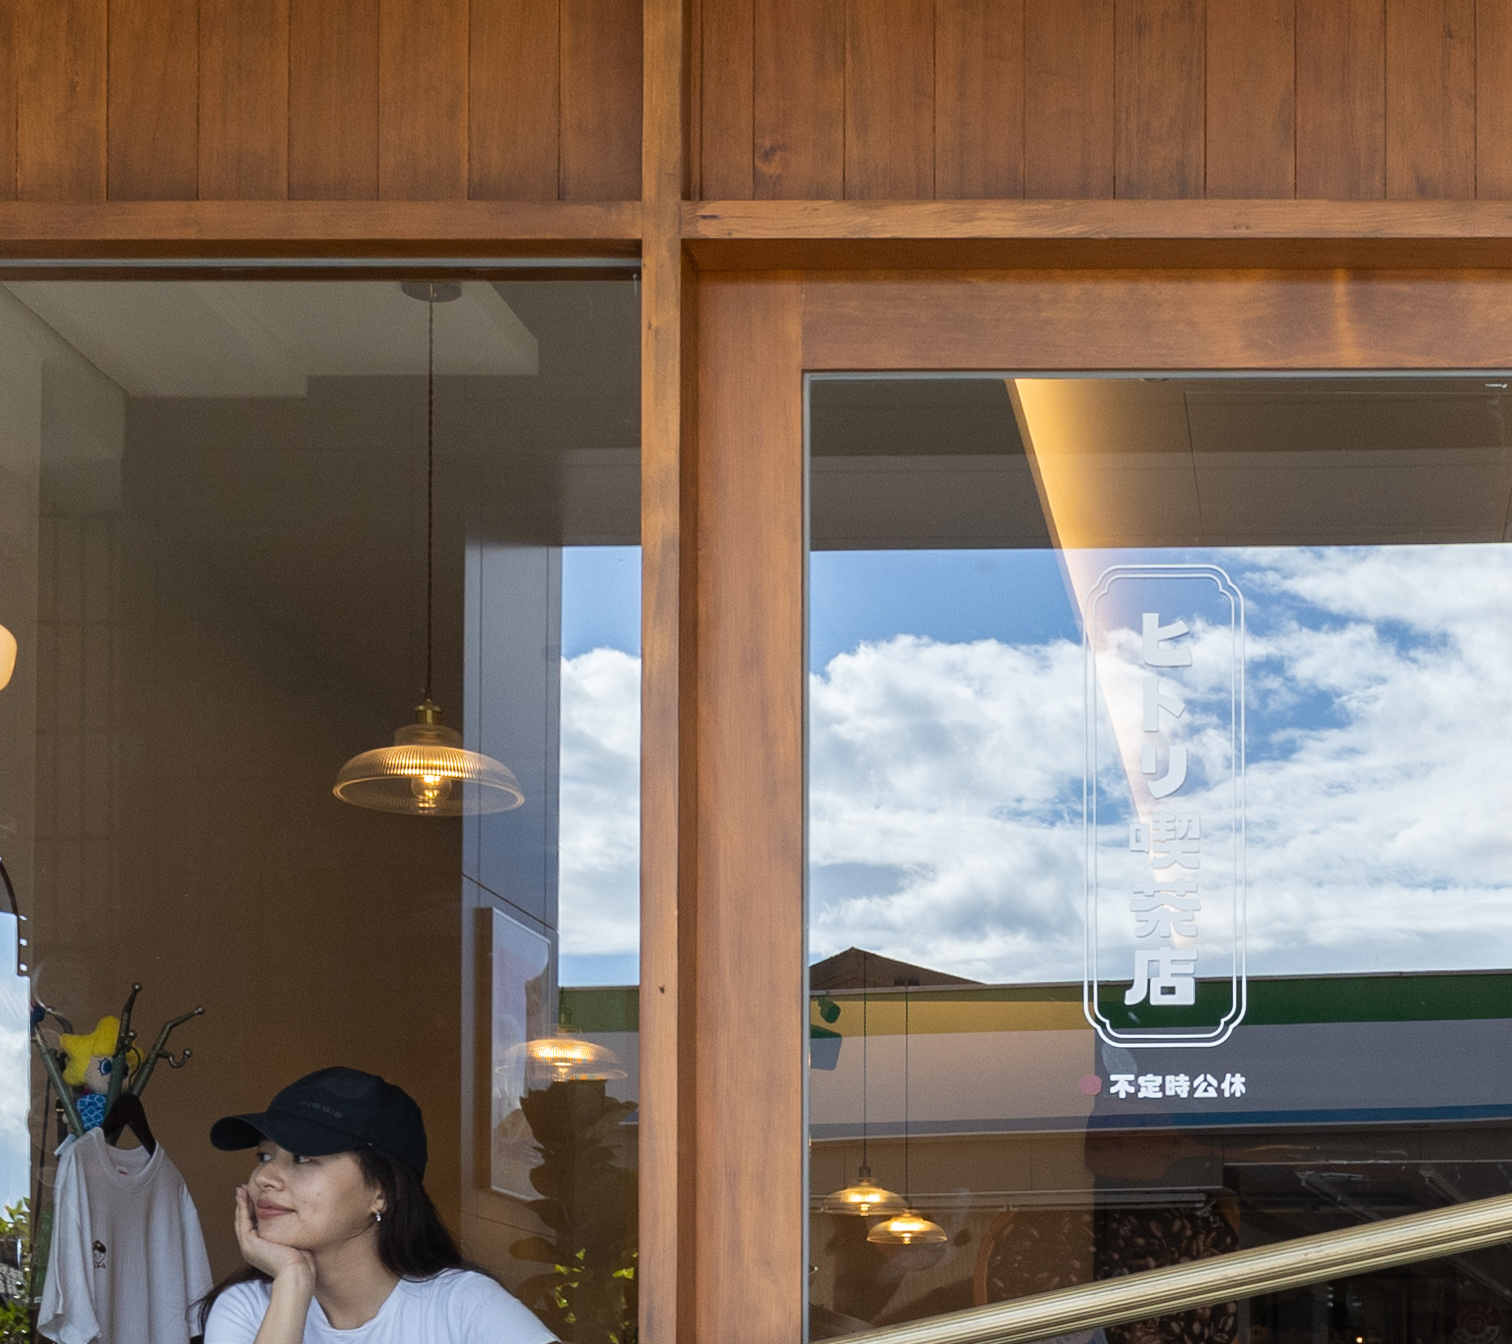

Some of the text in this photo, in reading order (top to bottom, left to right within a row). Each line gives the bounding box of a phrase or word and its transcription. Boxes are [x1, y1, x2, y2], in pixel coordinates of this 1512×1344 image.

[1124, 611, 1202, 1007] ヒトリ喫茶店
[1109, 1073, 1246, 1099] 不定時公休
